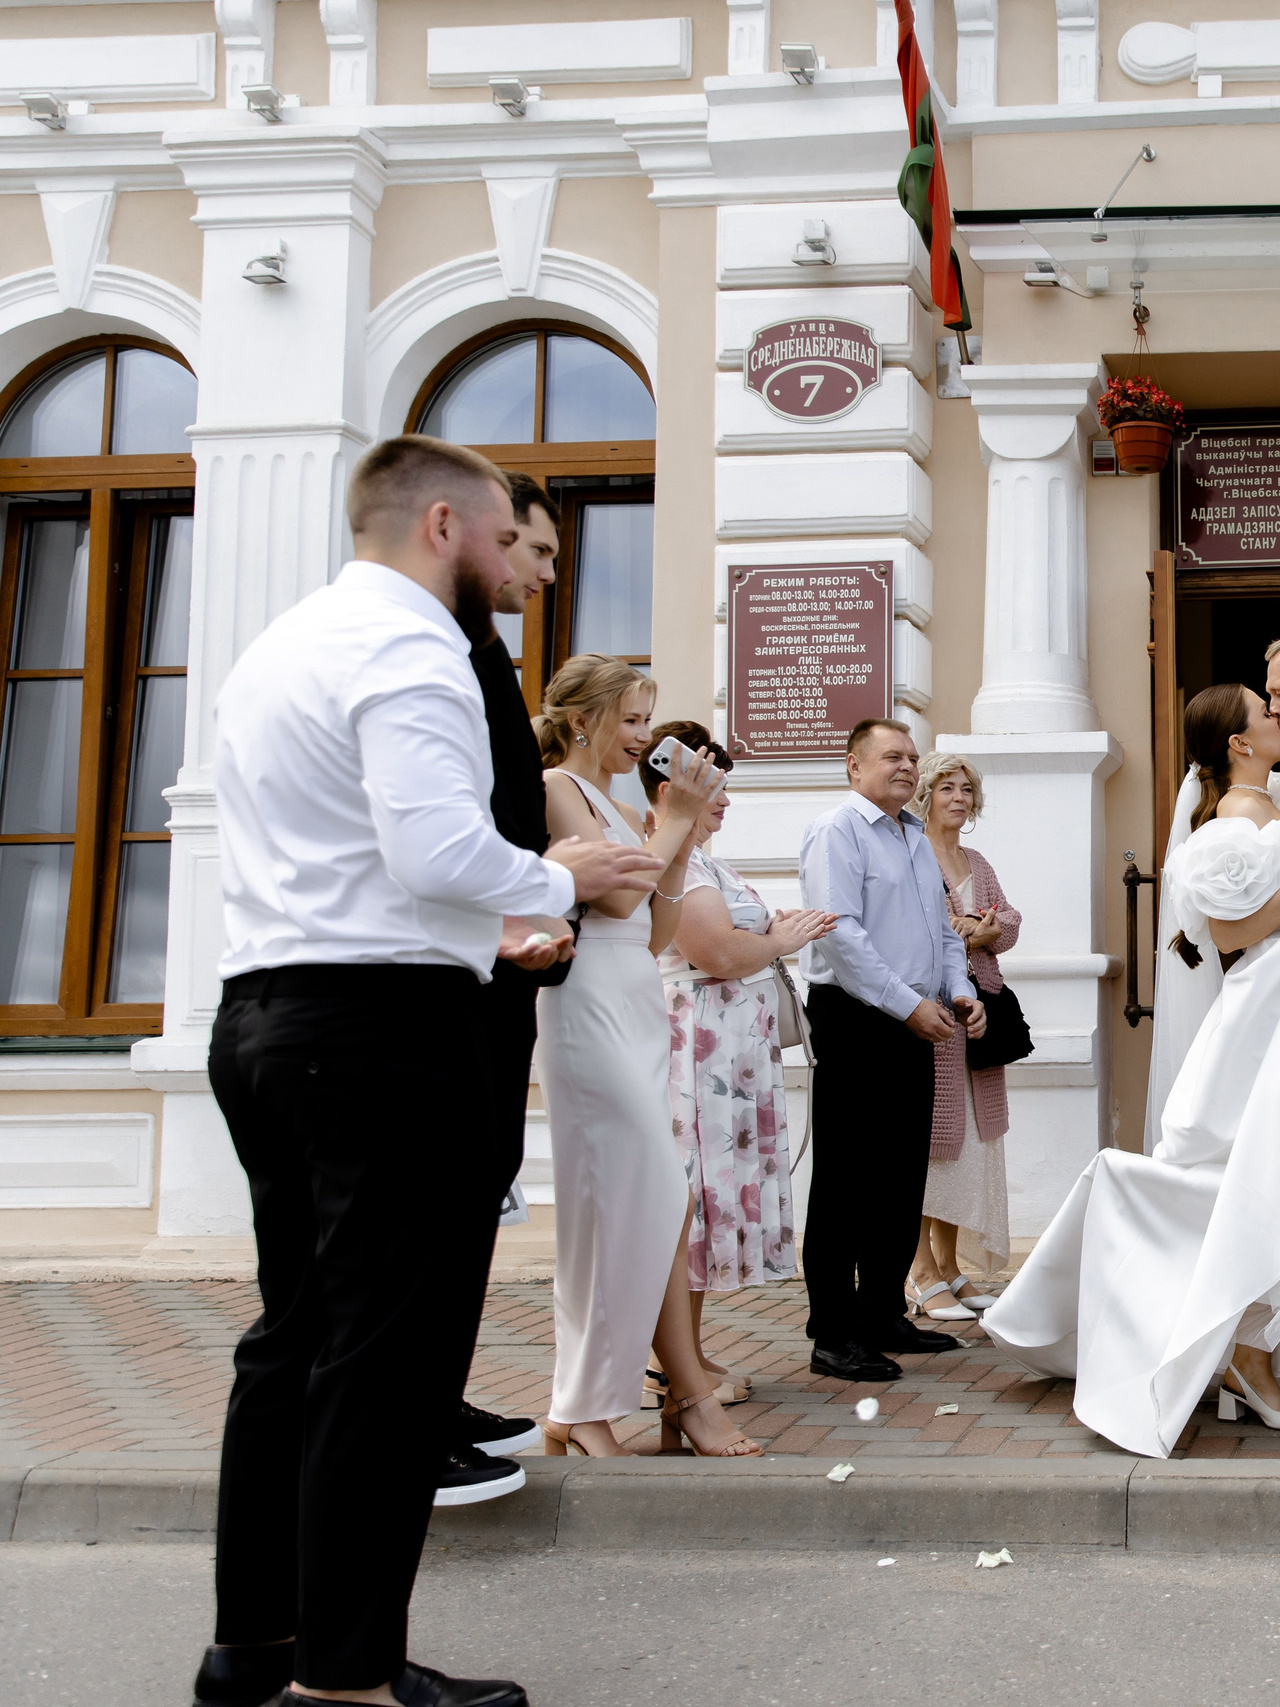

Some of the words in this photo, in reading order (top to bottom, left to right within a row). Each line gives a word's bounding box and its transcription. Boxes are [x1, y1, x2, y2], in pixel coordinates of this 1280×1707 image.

[790, 323, 835, 336] улица
[751, 336, 875, 372] СРЕДНЕНАБЕРЕЖНАЯ
[800, 375, 825, 408] 7
[1201, 438, 1251, 449] Віцебскі
[1196, 450, 1263, 461] выканаўчы
[1196, 477, 1273, 488] Чыгуначнага
[1191, 507, 1236, 521] АДДЗЕЛ
[1241, 537, 1277, 550] СТАНУ
[763, 578, 804, 587] РЕЖИМ
[810, 576, 860, 586] РАБОТЫ:
[819, 589, 860, 598] 14.00-20.00
[835, 601, 874, 610] 14.00-17.00
[766, 636, 808, 645] ГРАФИК
[812, 633, 855, 643] ПРИЁМА
[755, 645, 866, 655] ЗАИНТЕРЕСОВАННЫХ
[798, 656, 823, 665] ЛИЦ:
[826, 664, 872, 674] 14.00-20.00
[823, 675, 867, 685] 14.00-17.00
